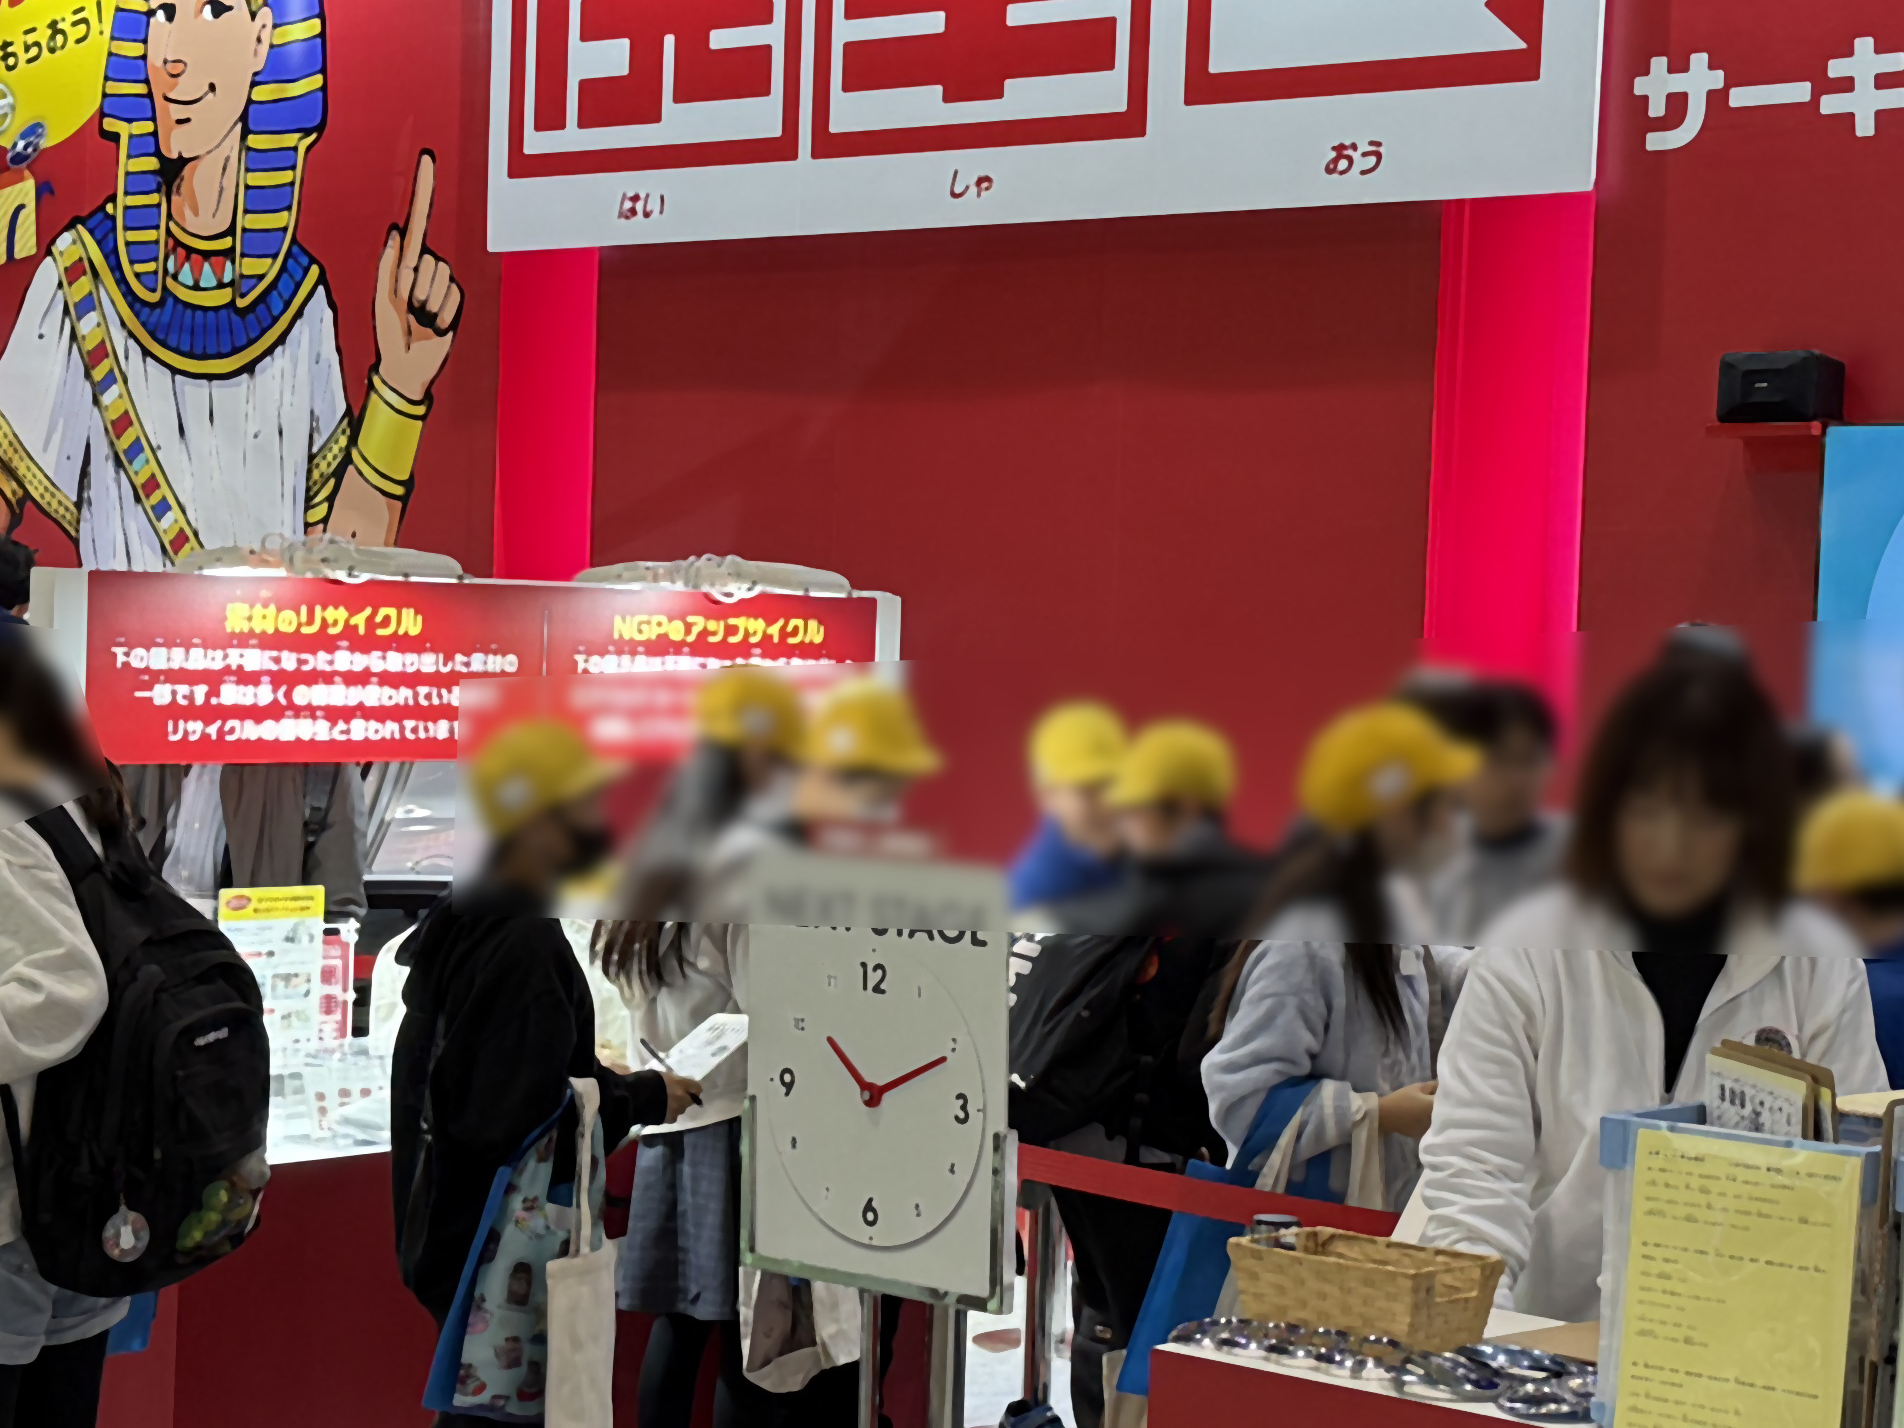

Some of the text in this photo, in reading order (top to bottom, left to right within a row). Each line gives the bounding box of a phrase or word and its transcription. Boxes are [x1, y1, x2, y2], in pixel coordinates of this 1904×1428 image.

[1323, 139, 1386, 176] おう
[948, 169, 995, 201] しゃ
[617, 189, 667, 222] はい
[859, 960, 888, 995] 12
[779, 1067, 796, 1098] 9
[953, 1092, 970, 1125] 3
[861, 1196, 879, 1228] 6
